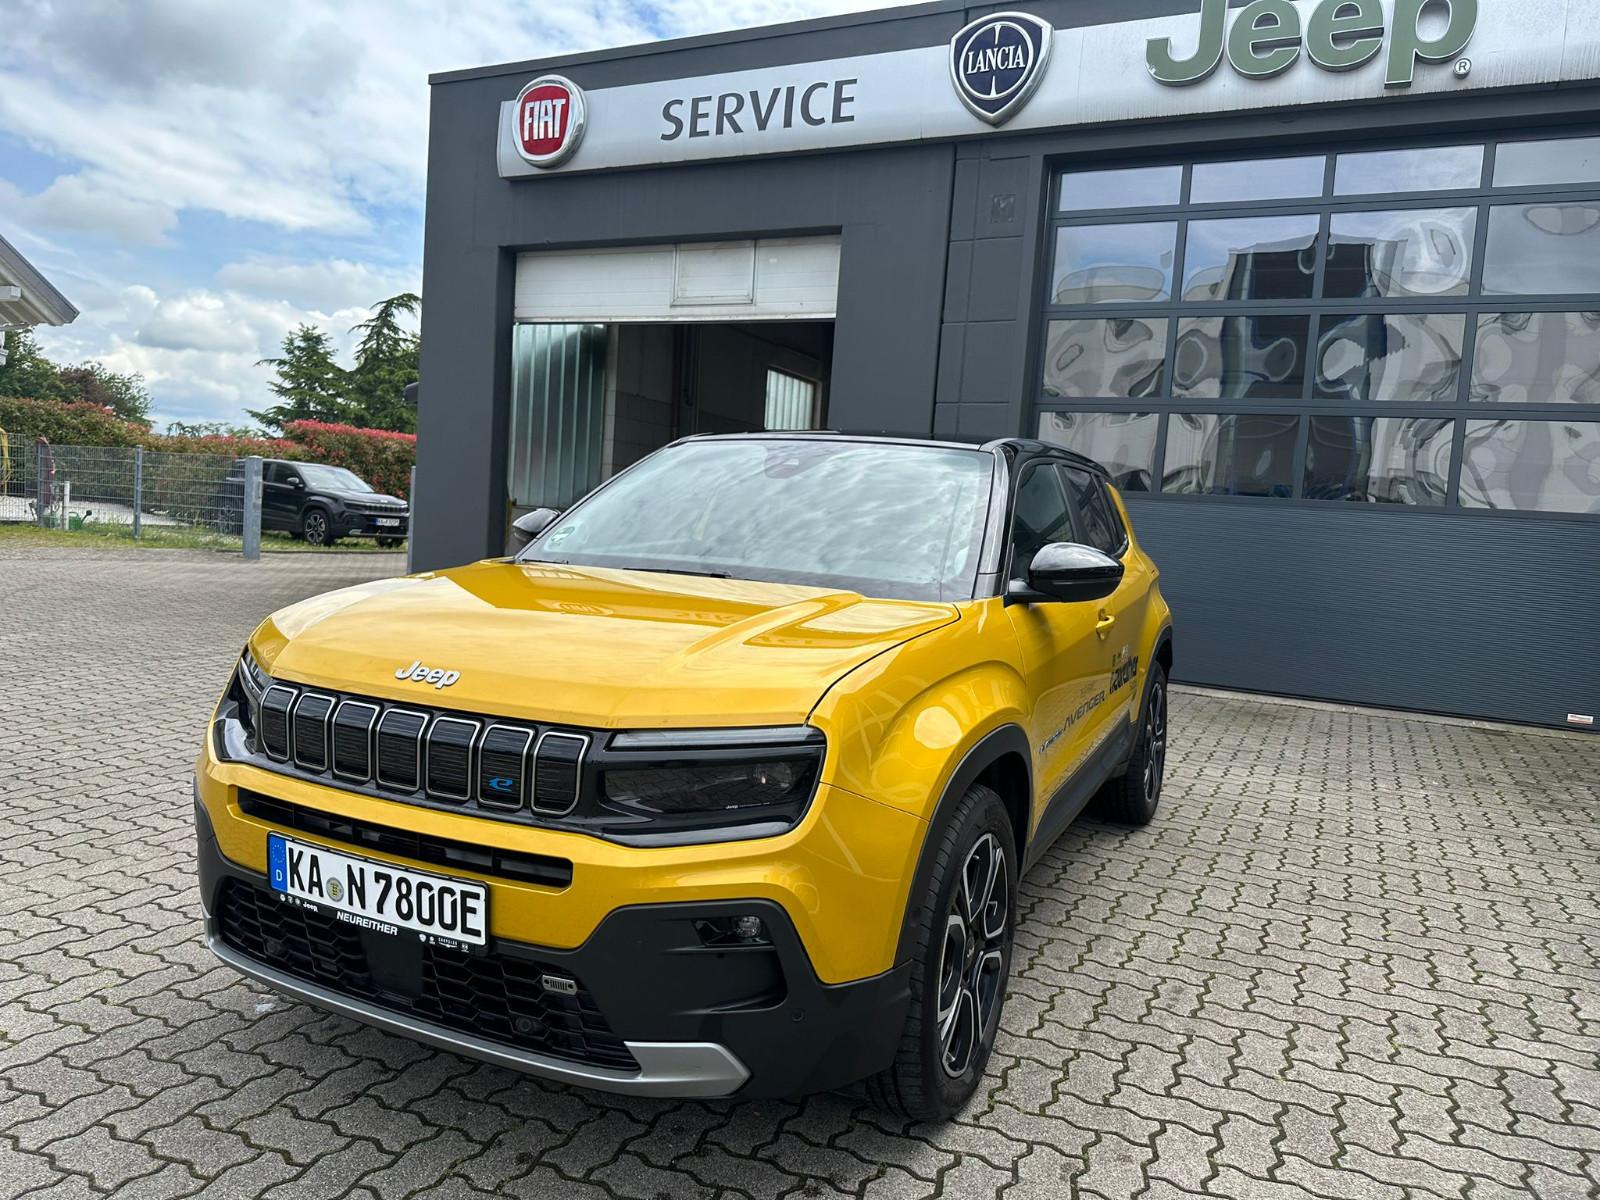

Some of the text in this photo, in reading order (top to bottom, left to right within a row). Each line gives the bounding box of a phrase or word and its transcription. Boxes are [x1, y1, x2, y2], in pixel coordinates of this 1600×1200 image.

[966, 44, 1026, 75] LANCIA
[1145, 0, 1480, 89] Jeep
[523, 98, 567, 142] FIAT
[660, 78, 858, 141] SERVICE
[395, 660, 461, 690] Jeep
[275, 869, 283, 882] D
[288, 847, 324, 898] KA
[336, 911, 399, 936] NEUREITHER
